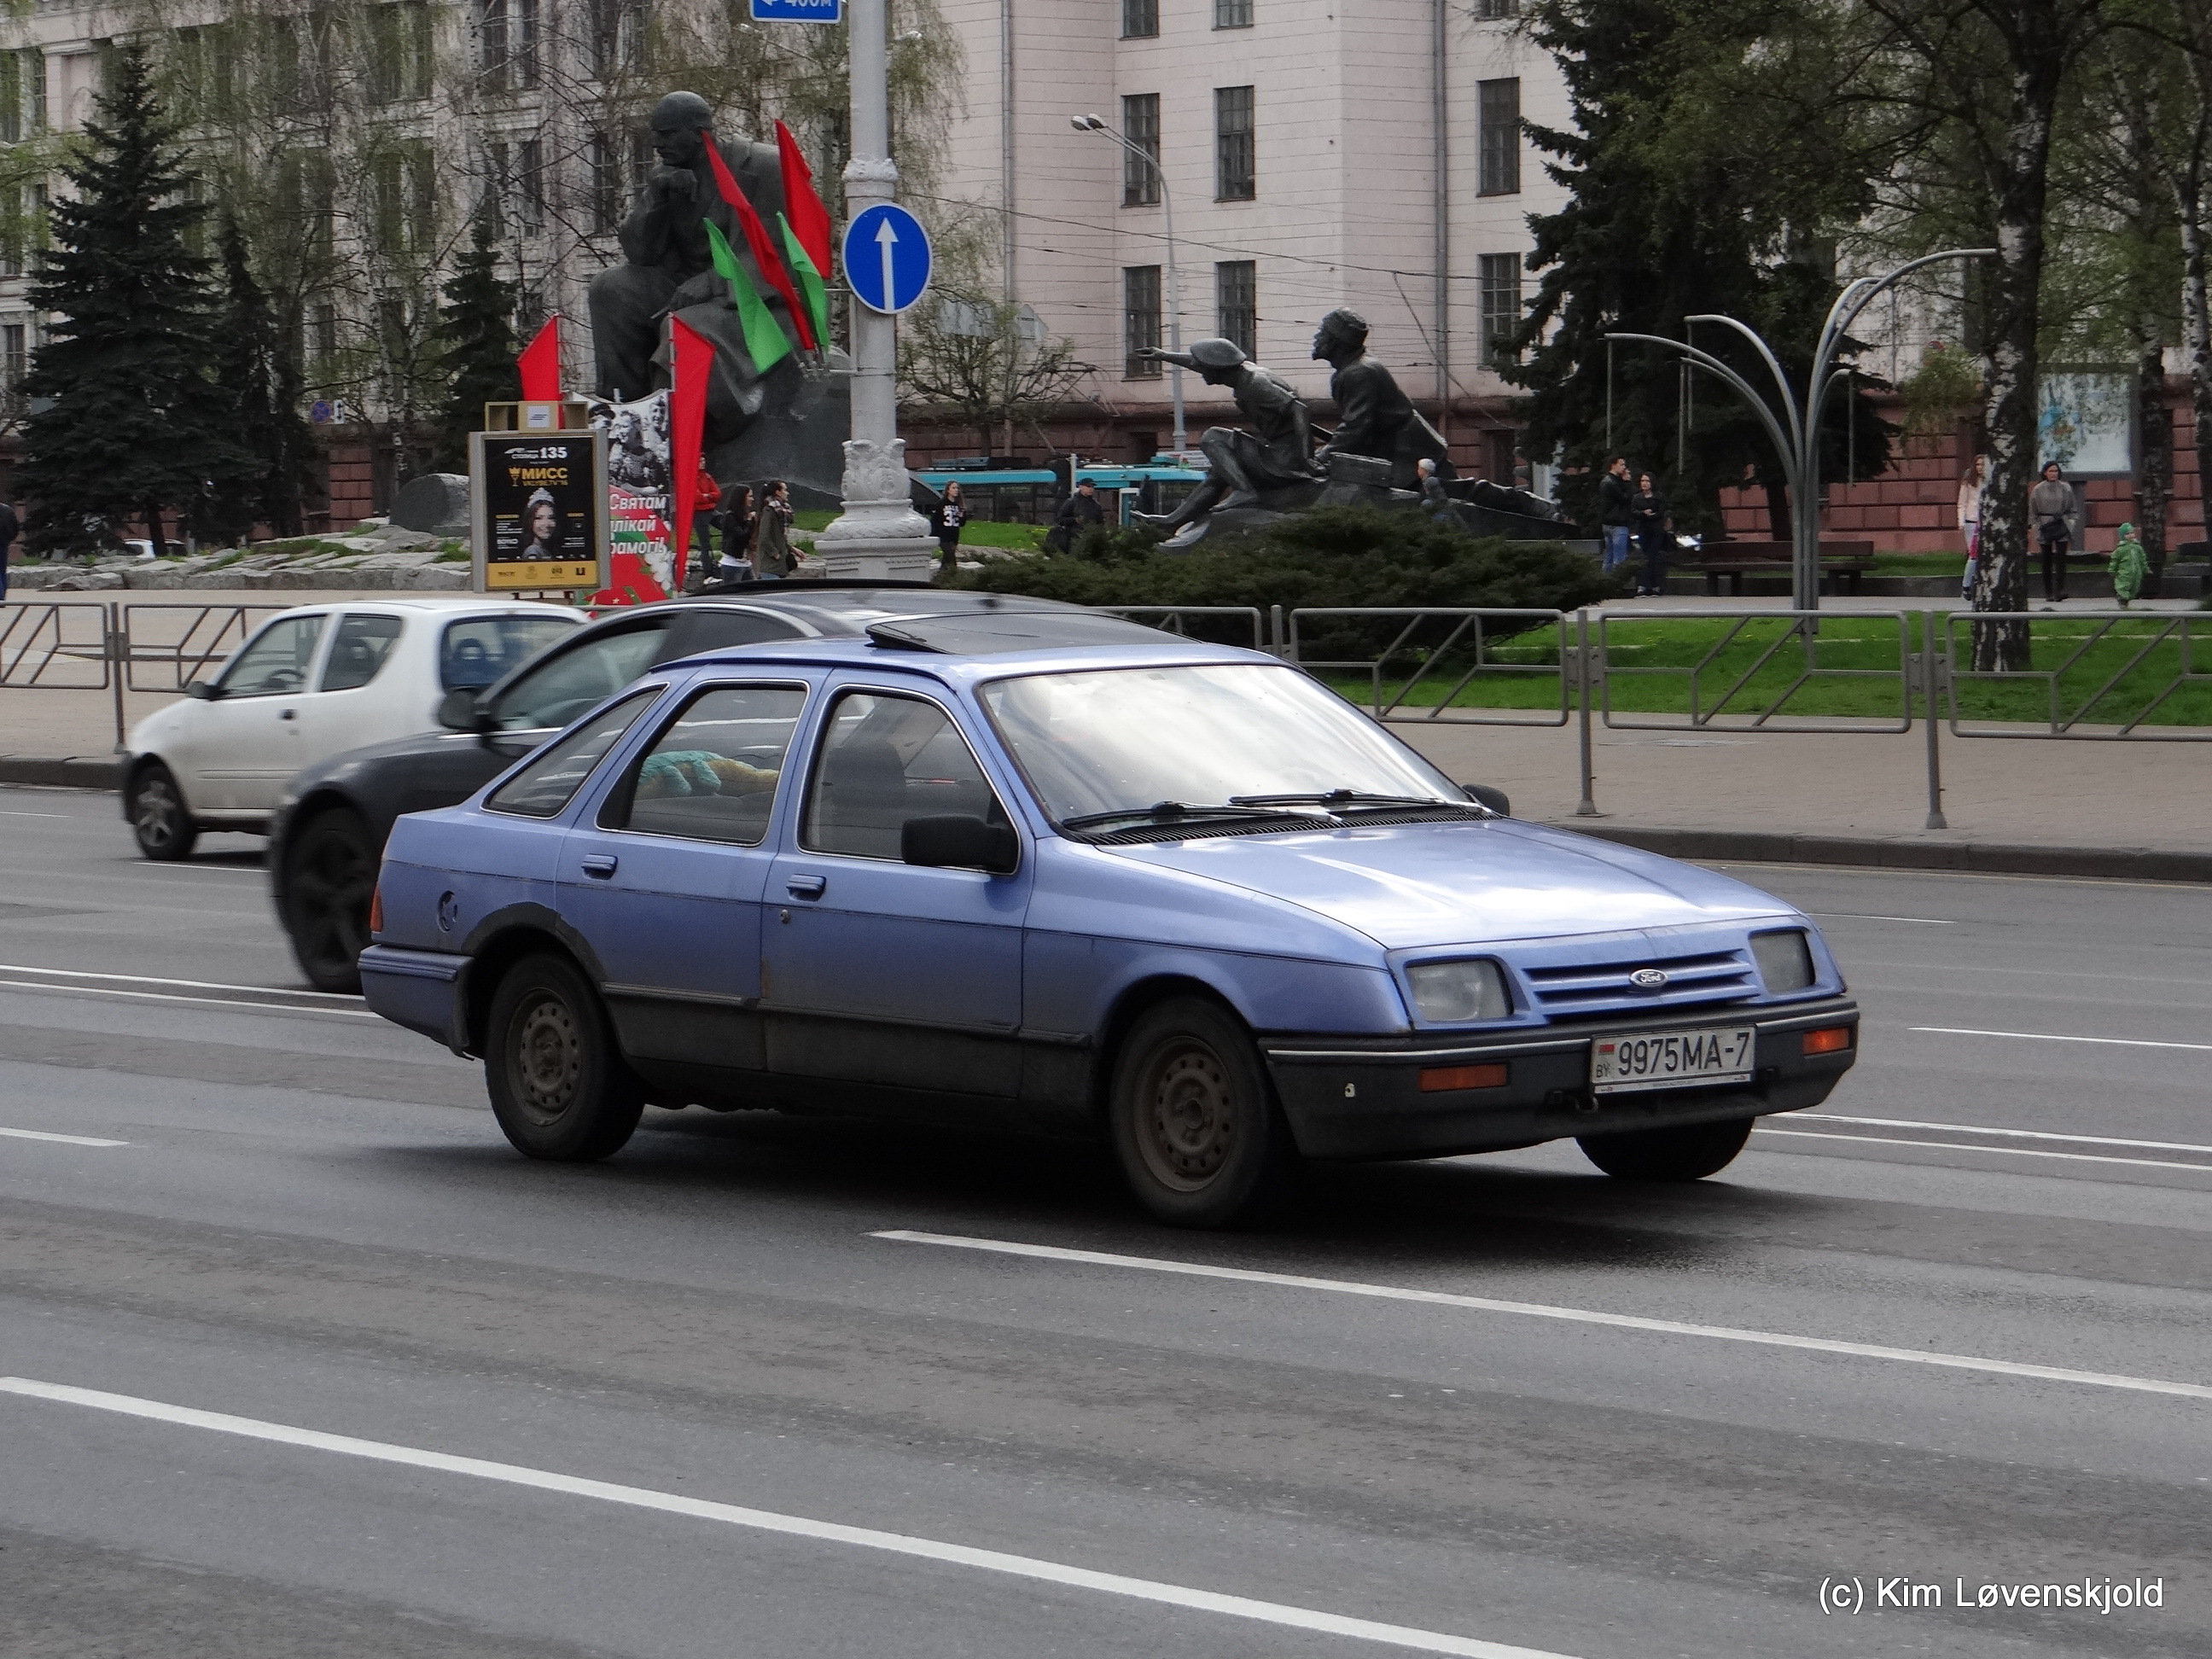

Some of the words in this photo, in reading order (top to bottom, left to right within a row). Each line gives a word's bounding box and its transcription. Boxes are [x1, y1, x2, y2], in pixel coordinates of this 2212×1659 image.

[540, 446, 568, 459] 135
[521, 467, 568, 480] МИСС
[609, 493, 667, 509] Святам
[1618, 1032, 1750, 1075] 9975MA-7
